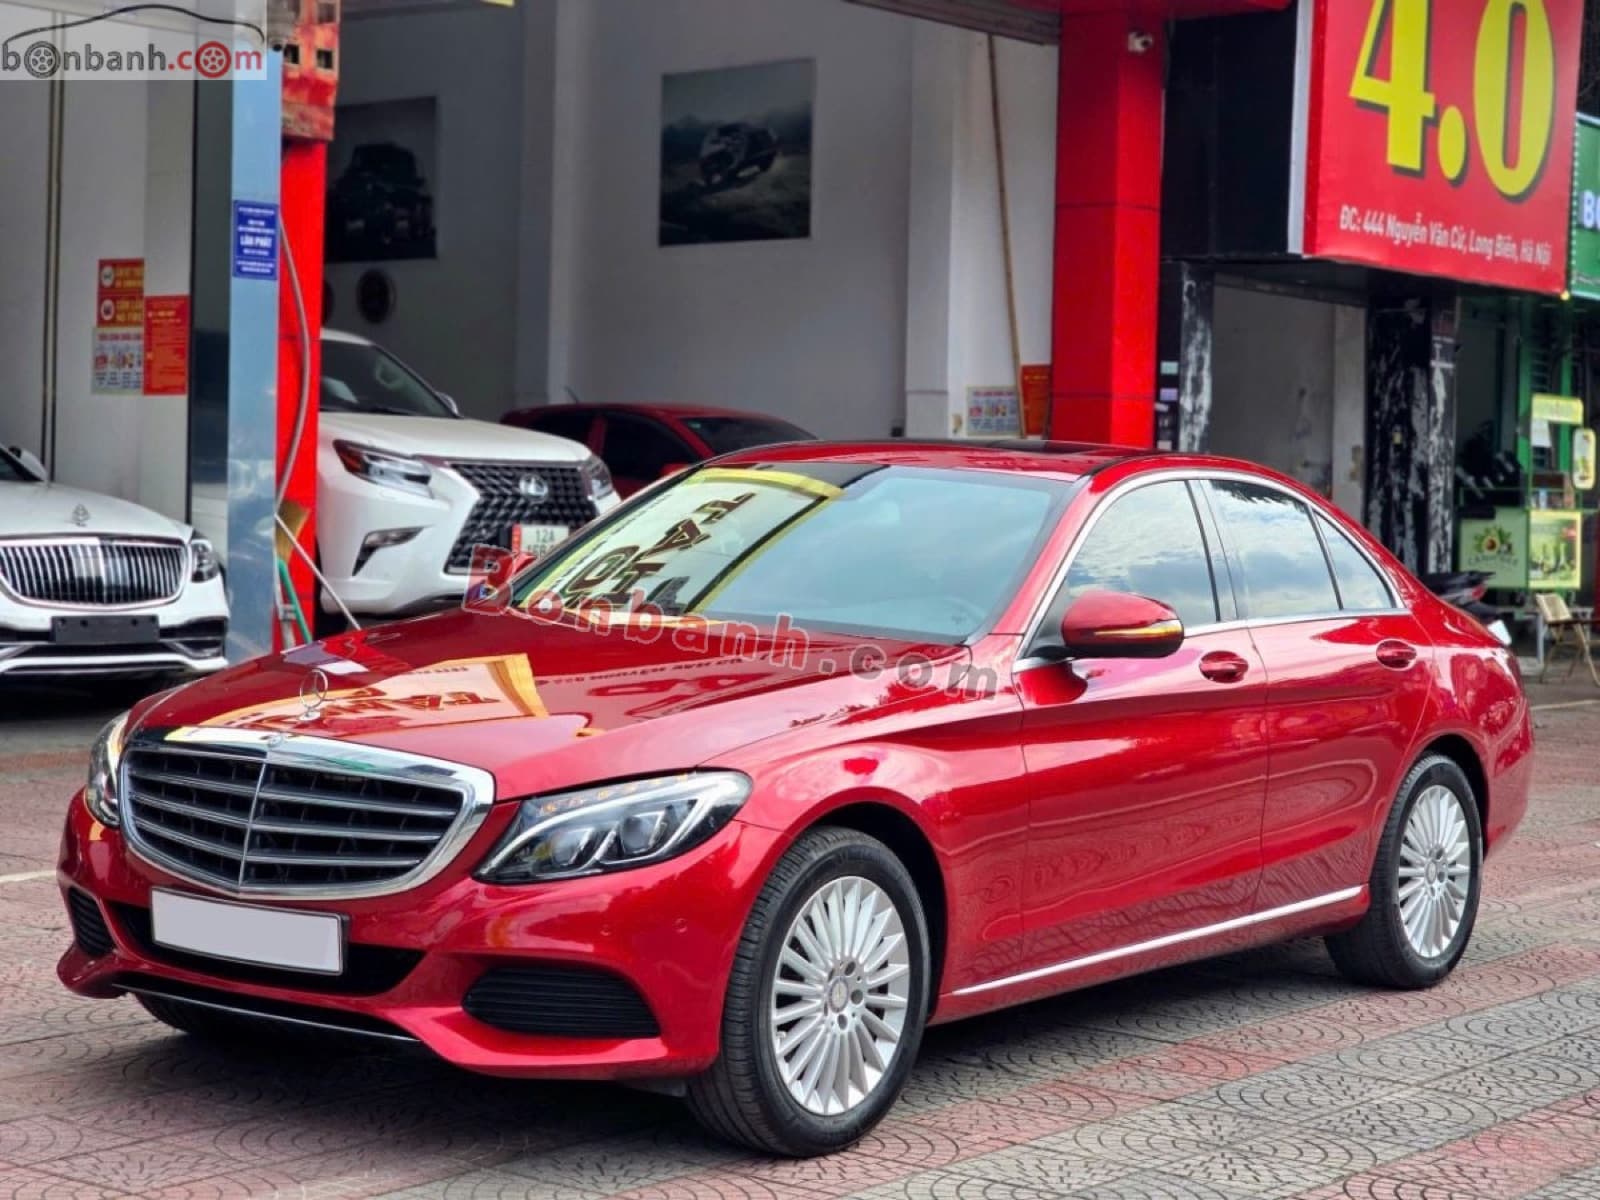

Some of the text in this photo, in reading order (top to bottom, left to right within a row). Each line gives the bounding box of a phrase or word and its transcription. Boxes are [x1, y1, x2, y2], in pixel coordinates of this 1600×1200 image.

[1349, 0, 1555, 196] 4.0
[1362, 209, 1385, 237] 444
[1386, 211, 1428, 248] Nguyễn
[1430, 220, 1450, 248] Văn
[1468, 228, 1494, 262] Long
[1520, 238, 1534, 264] Hà
[1535, 240, 1553, 271] Nội
